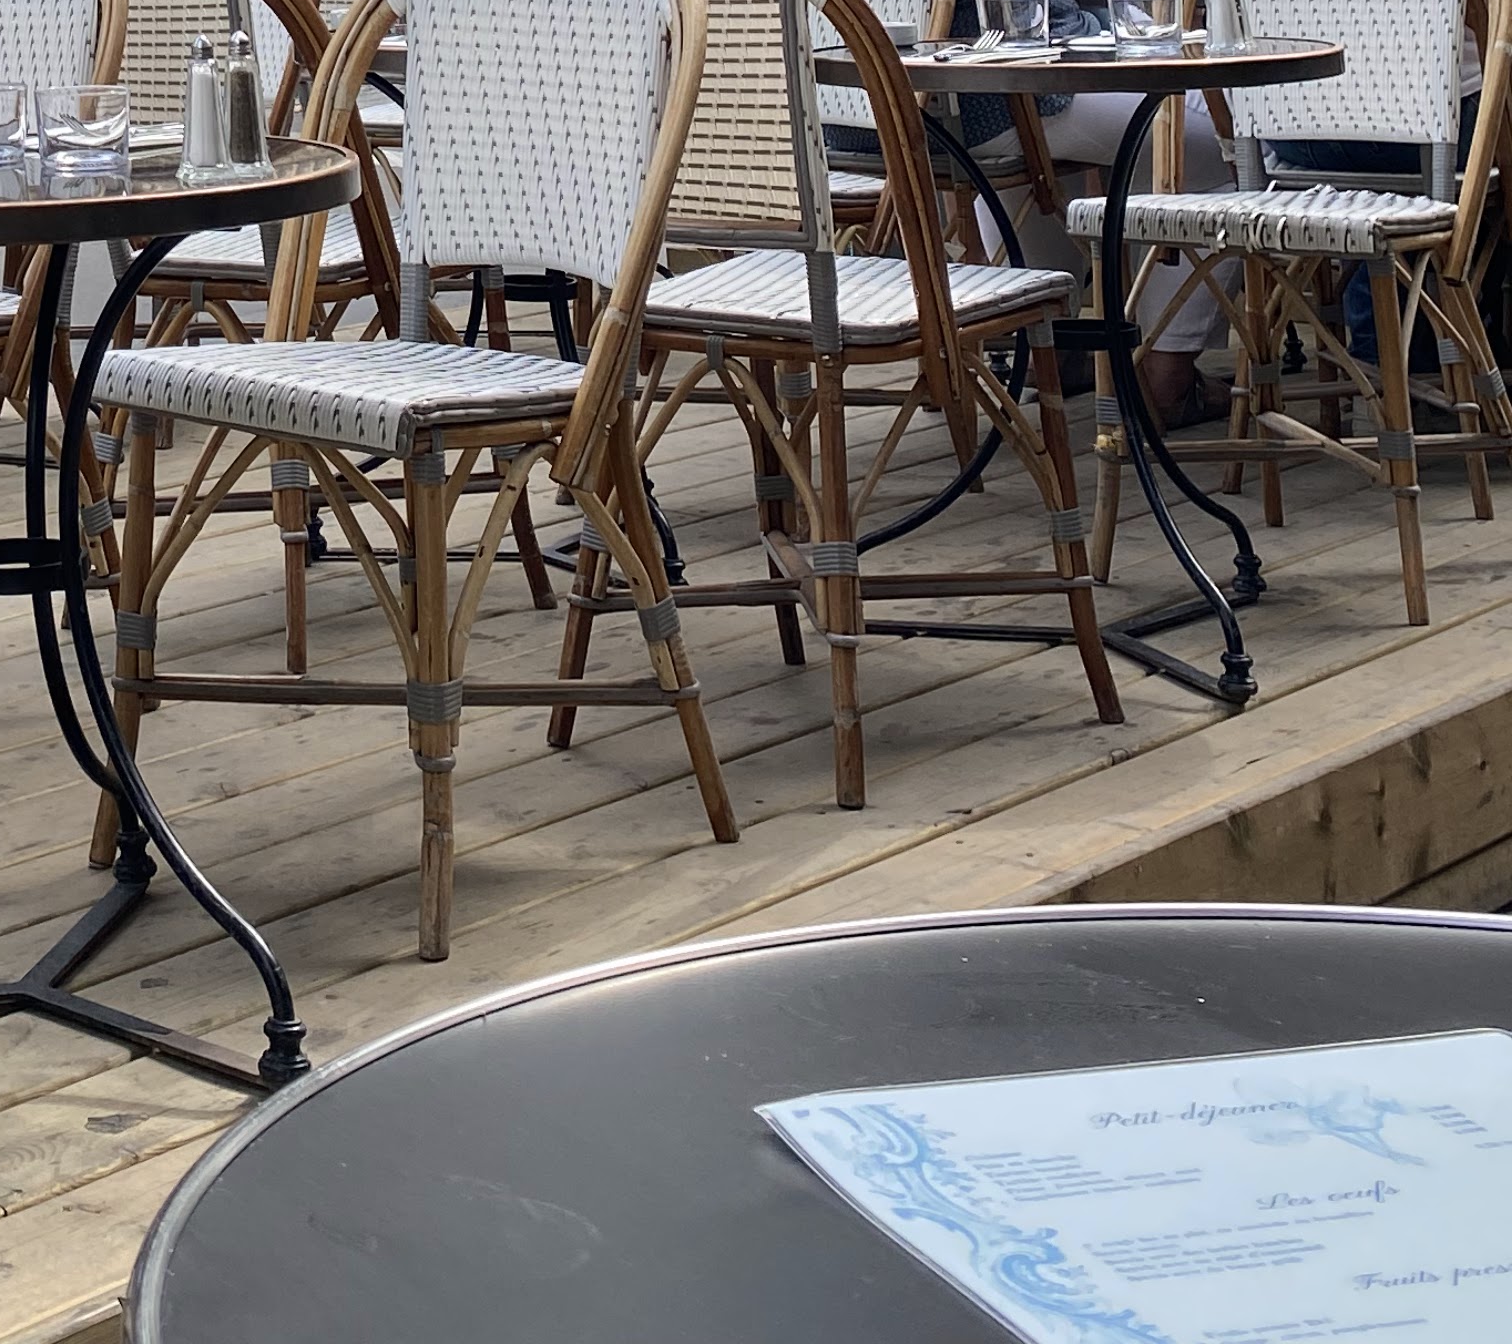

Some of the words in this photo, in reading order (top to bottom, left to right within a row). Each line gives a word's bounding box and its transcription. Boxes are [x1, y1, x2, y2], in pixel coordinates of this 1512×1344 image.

[1089, 1101, 1299, 1129] Petit-déjeuner
[1256, 1192, 1316, 1211] Les
[1353, 1270, 1441, 1291] Fruits
[1453, 1261, 1512, 1287] pres
